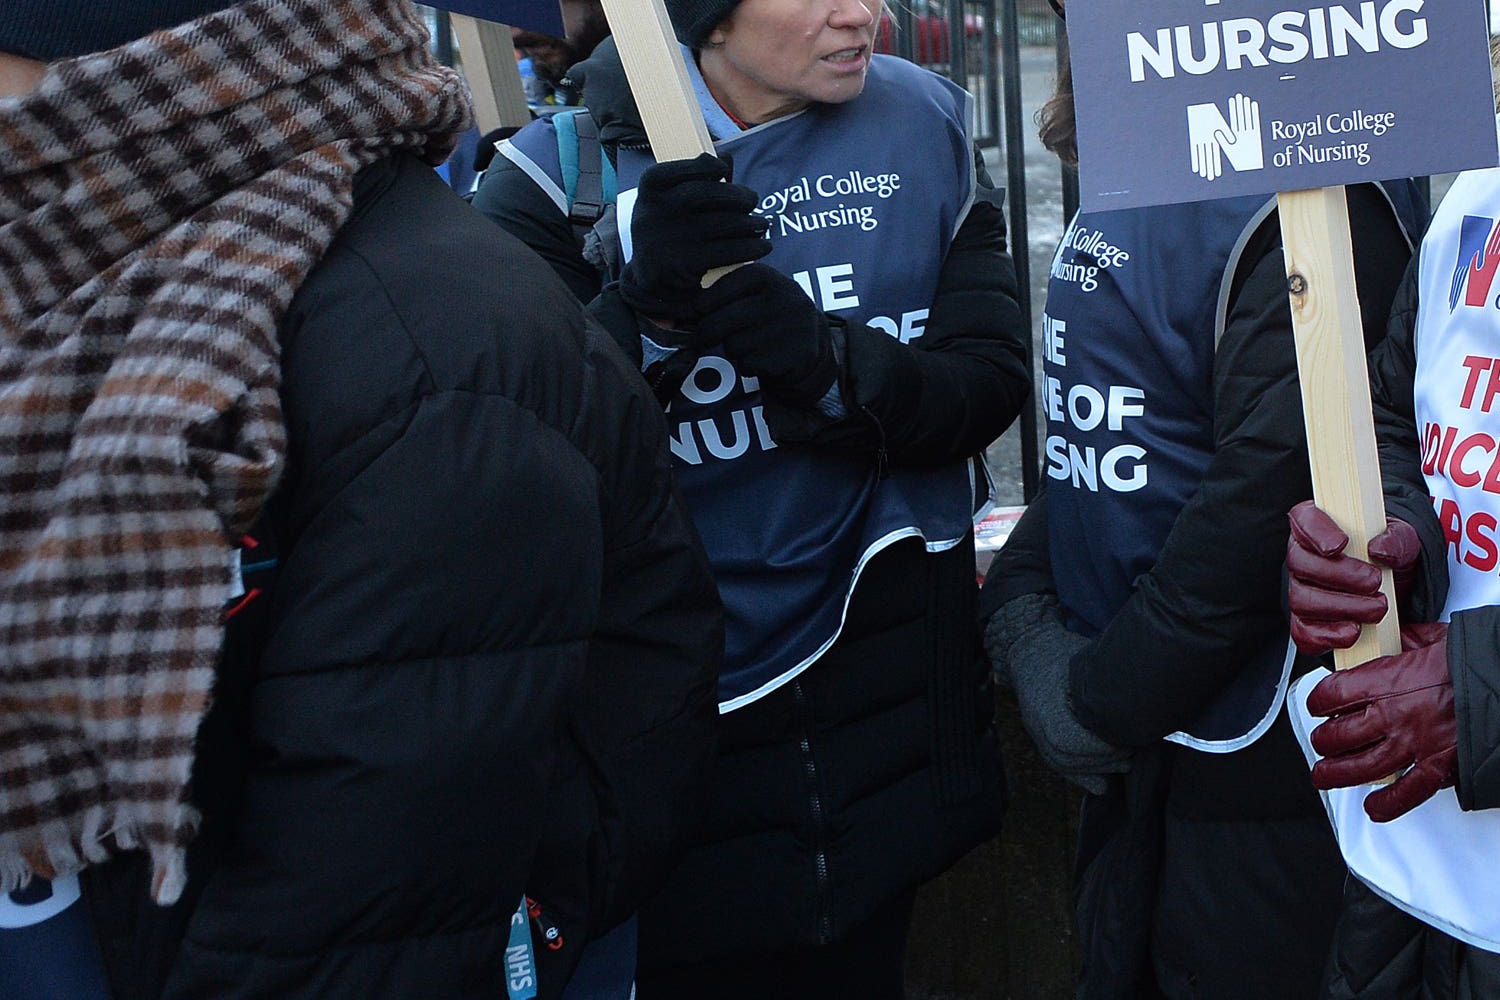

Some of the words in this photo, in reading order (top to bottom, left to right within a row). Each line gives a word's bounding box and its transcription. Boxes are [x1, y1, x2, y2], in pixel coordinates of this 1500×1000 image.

[1271, 113, 1322, 146] Royal
[1327, 109, 1395, 136] College
[1273, 144, 1294, 168] of
[1297, 140, 1371, 166] Nursing
[816, 170, 901, 199] College
[779, 204, 878, 237] Nursing
[1072, 227, 1130, 269] College
[1067, 384, 1145, 432] OF
[506, 943, 532, 992] NHS
